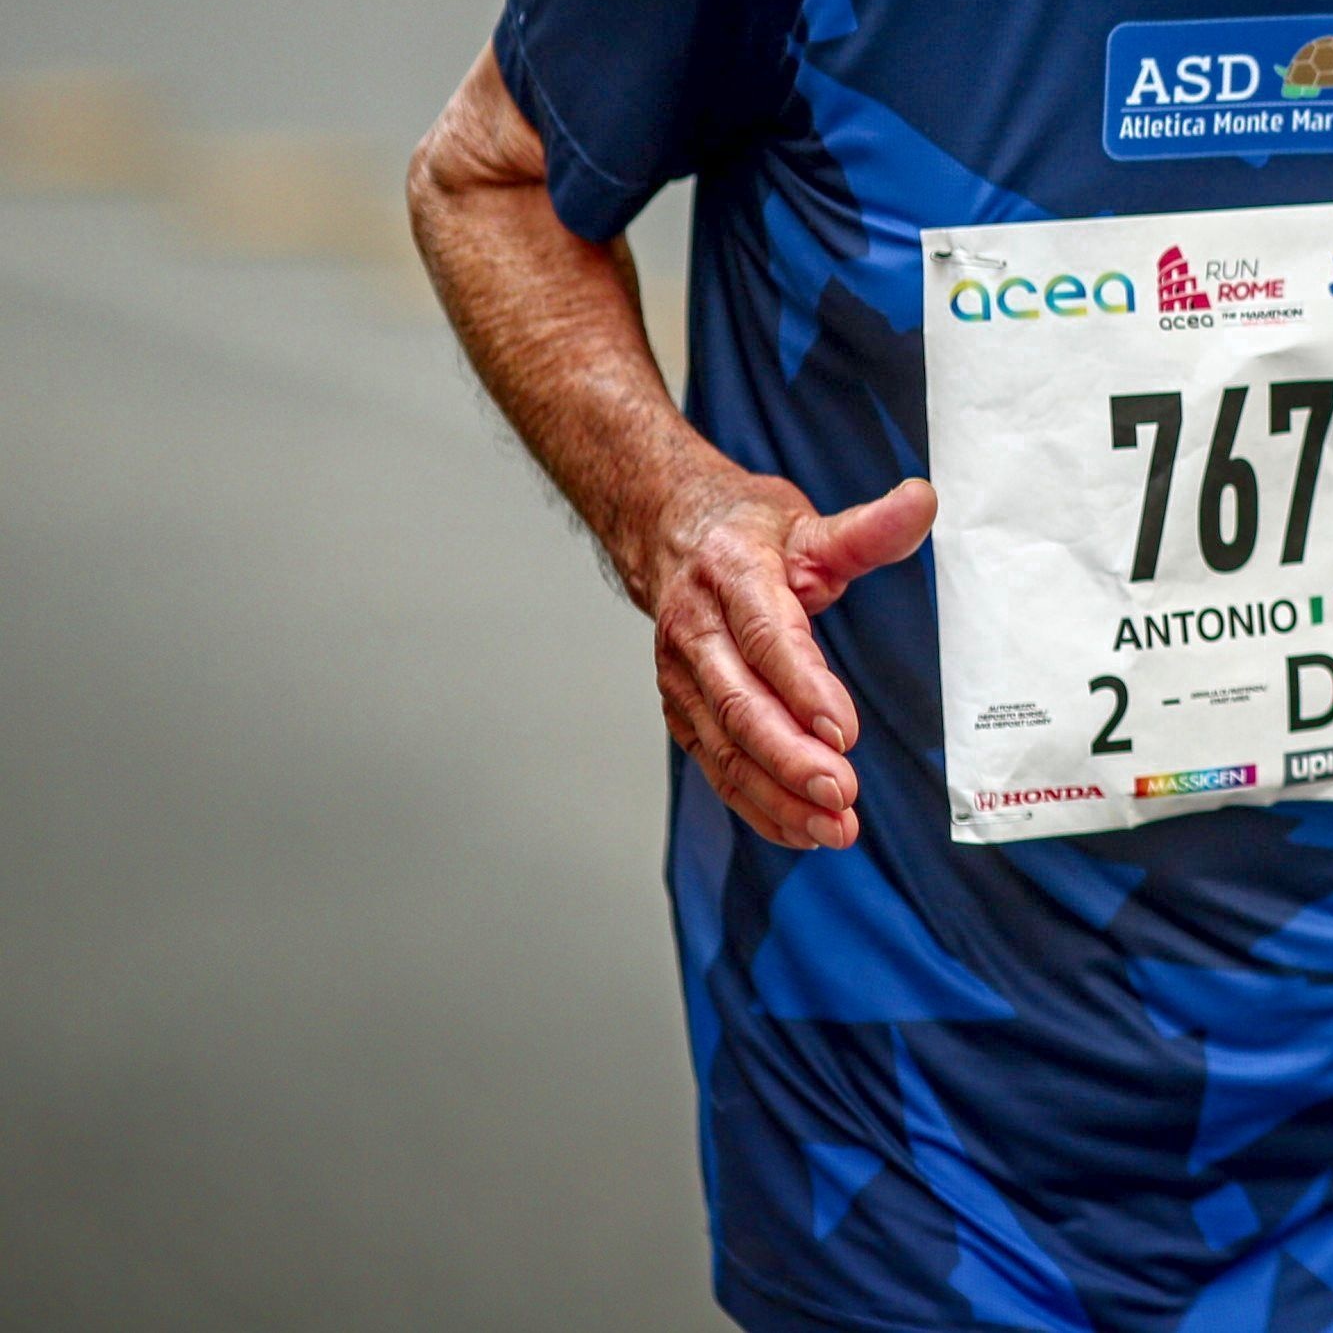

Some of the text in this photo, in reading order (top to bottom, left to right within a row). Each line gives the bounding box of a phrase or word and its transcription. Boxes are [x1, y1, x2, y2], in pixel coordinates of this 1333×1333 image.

[1125, 54, 1261, 105] ASD
[1120, 113, 1205, 139] Atletica
[1213, 110, 1284, 135] Monte
[1205, 258, 1260, 281] RUN
[950, 271, 1136, 323] acea
[1217, 279, 1285, 303] ROME
[1159, 313, 1214, 331] acea
[1113, 598, 1298, 653] ANTONIO
[1087, 673, 1133, 757] 2
[1146, 767, 1248, 795] MASSIGEN
[1001, 785, 1106, 808] HONDA
